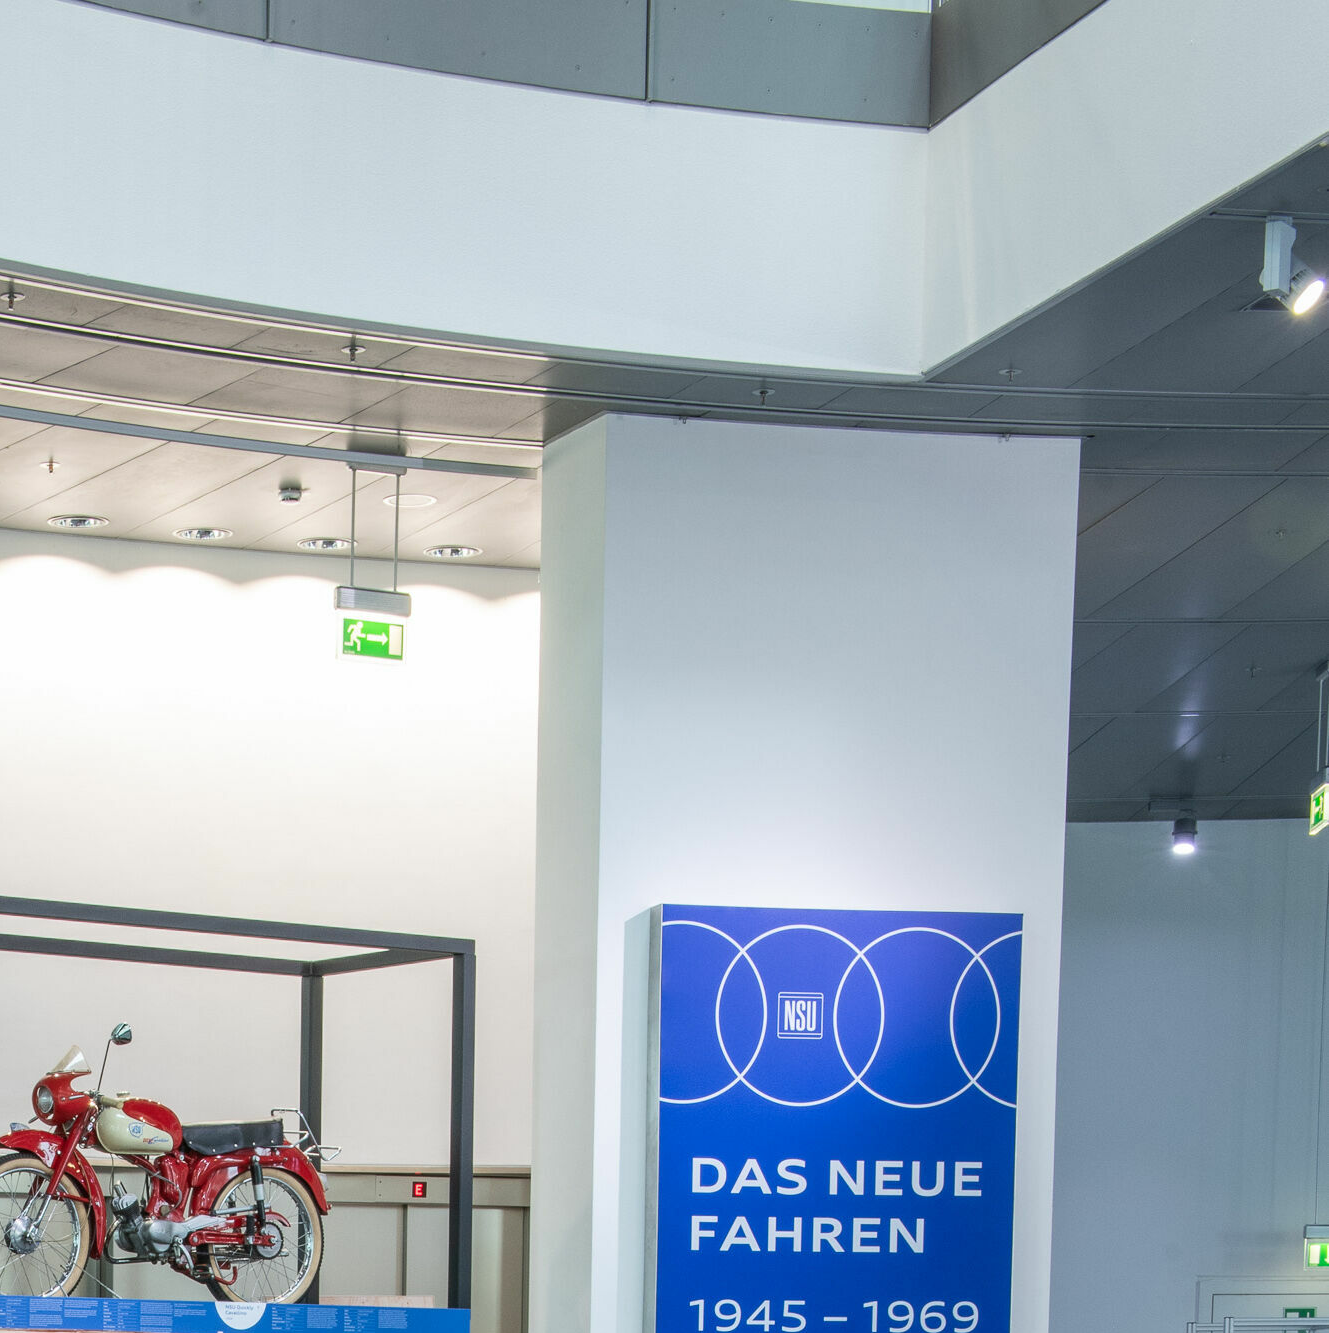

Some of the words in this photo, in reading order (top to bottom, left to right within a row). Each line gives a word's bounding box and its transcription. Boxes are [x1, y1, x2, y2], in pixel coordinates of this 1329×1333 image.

[784, 998, 818, 1033] NSU
[415, 1184, 423, 1196] E
[691, 1157, 808, 1195] DAS
[830, 1160, 983, 1198] NEUE
[690, 1215, 925, 1253] FAHREN
[689, 1298, 808, 1333] 1945
[862, 1300, 979, 1333] 1969
